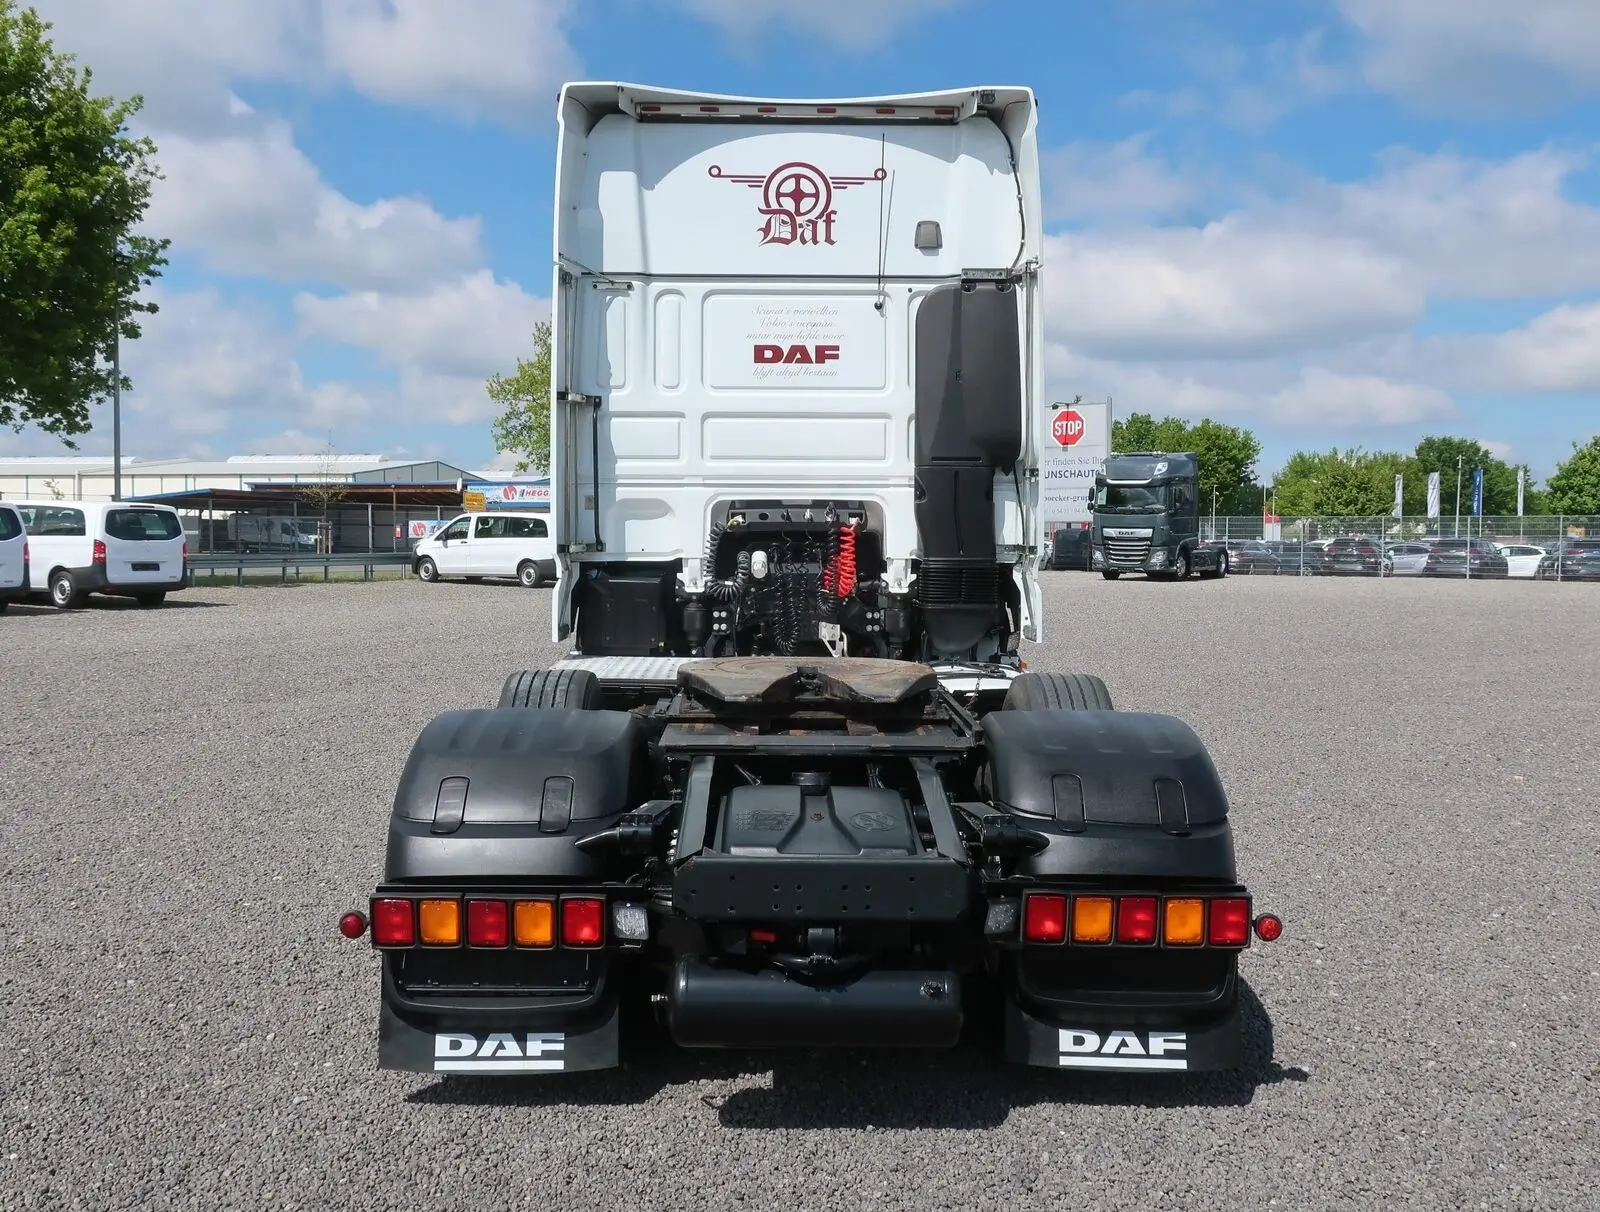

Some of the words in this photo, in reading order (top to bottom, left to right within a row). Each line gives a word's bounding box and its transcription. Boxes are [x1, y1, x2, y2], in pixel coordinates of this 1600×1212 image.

[757, 207, 838, 247] Daf
[754, 345, 840, 364] DAF
[1055, 420, 1082, 435] STOP
[1052, 457, 1076, 466] finden
[1077, 457, 1090, 465] Sie
[525, 489, 550, 497] HEGG
[435, 1033, 565, 1057] DAF
[1059, 1029, 1187, 1055] DAF
